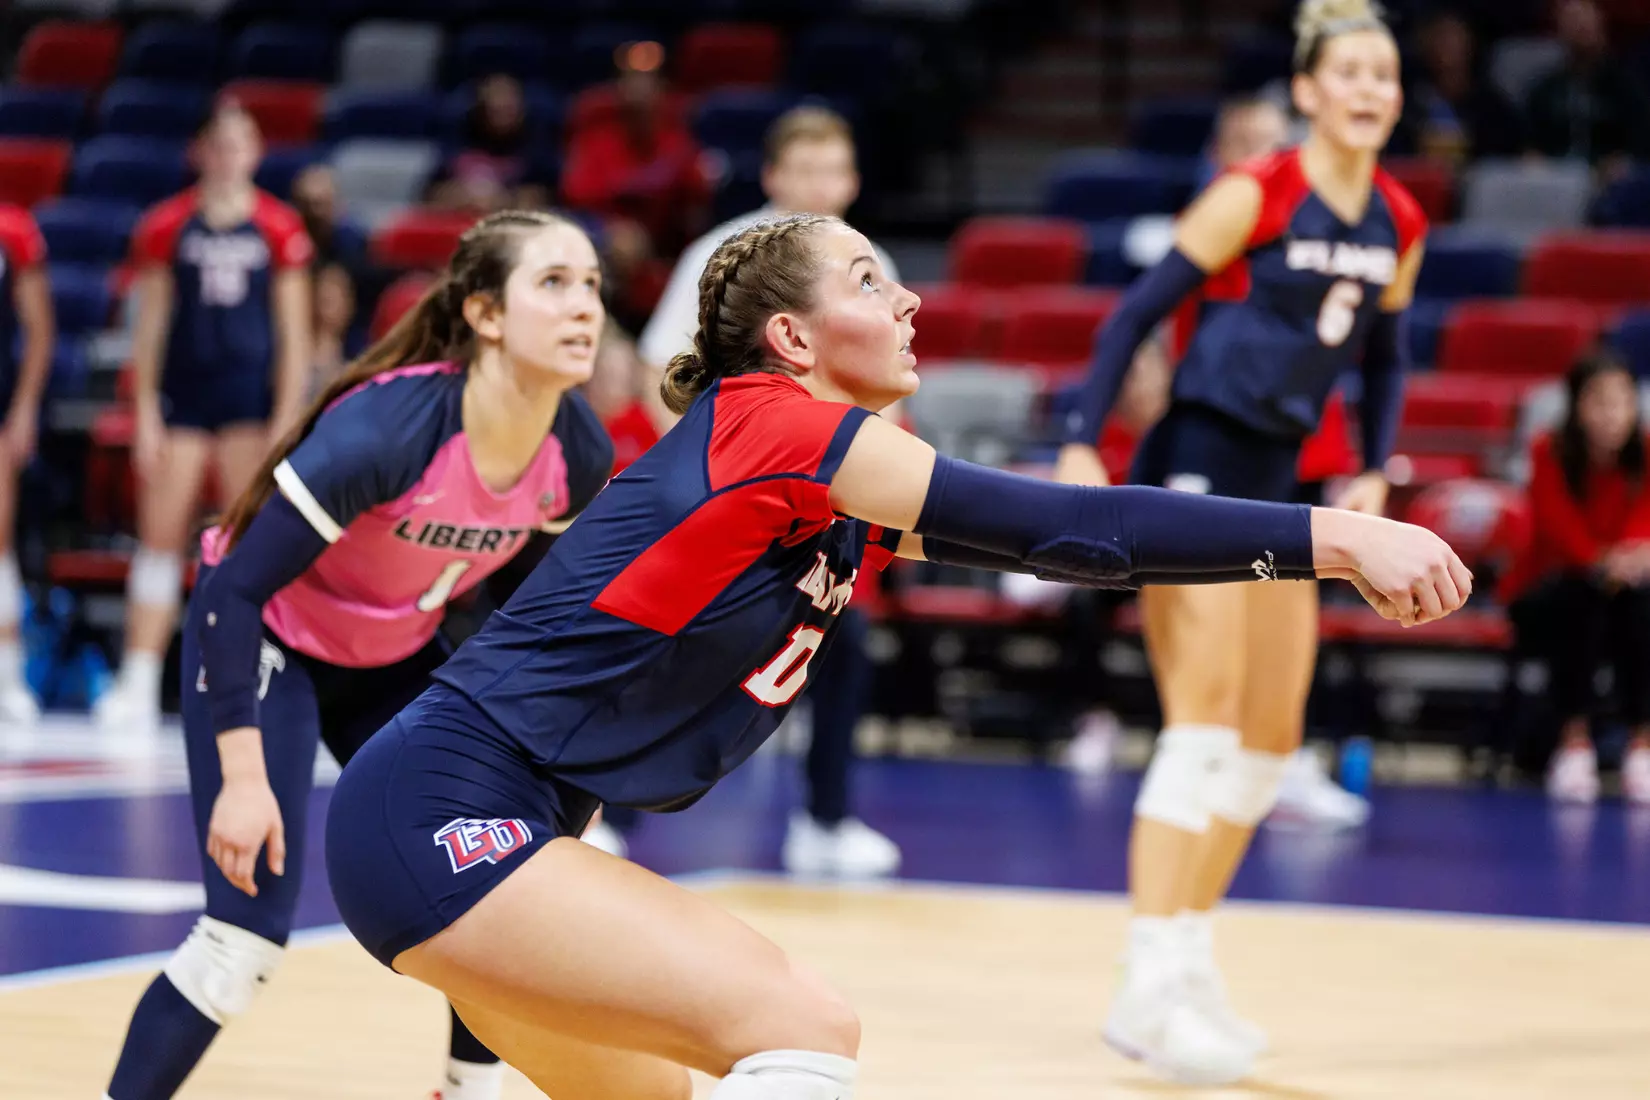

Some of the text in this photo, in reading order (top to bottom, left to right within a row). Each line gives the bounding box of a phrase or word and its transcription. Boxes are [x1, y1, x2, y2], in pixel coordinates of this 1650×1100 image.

[1316, 278, 1364, 347] 6
[393, 517, 530, 554] LIBERT
[416, 559, 471, 613] 1
